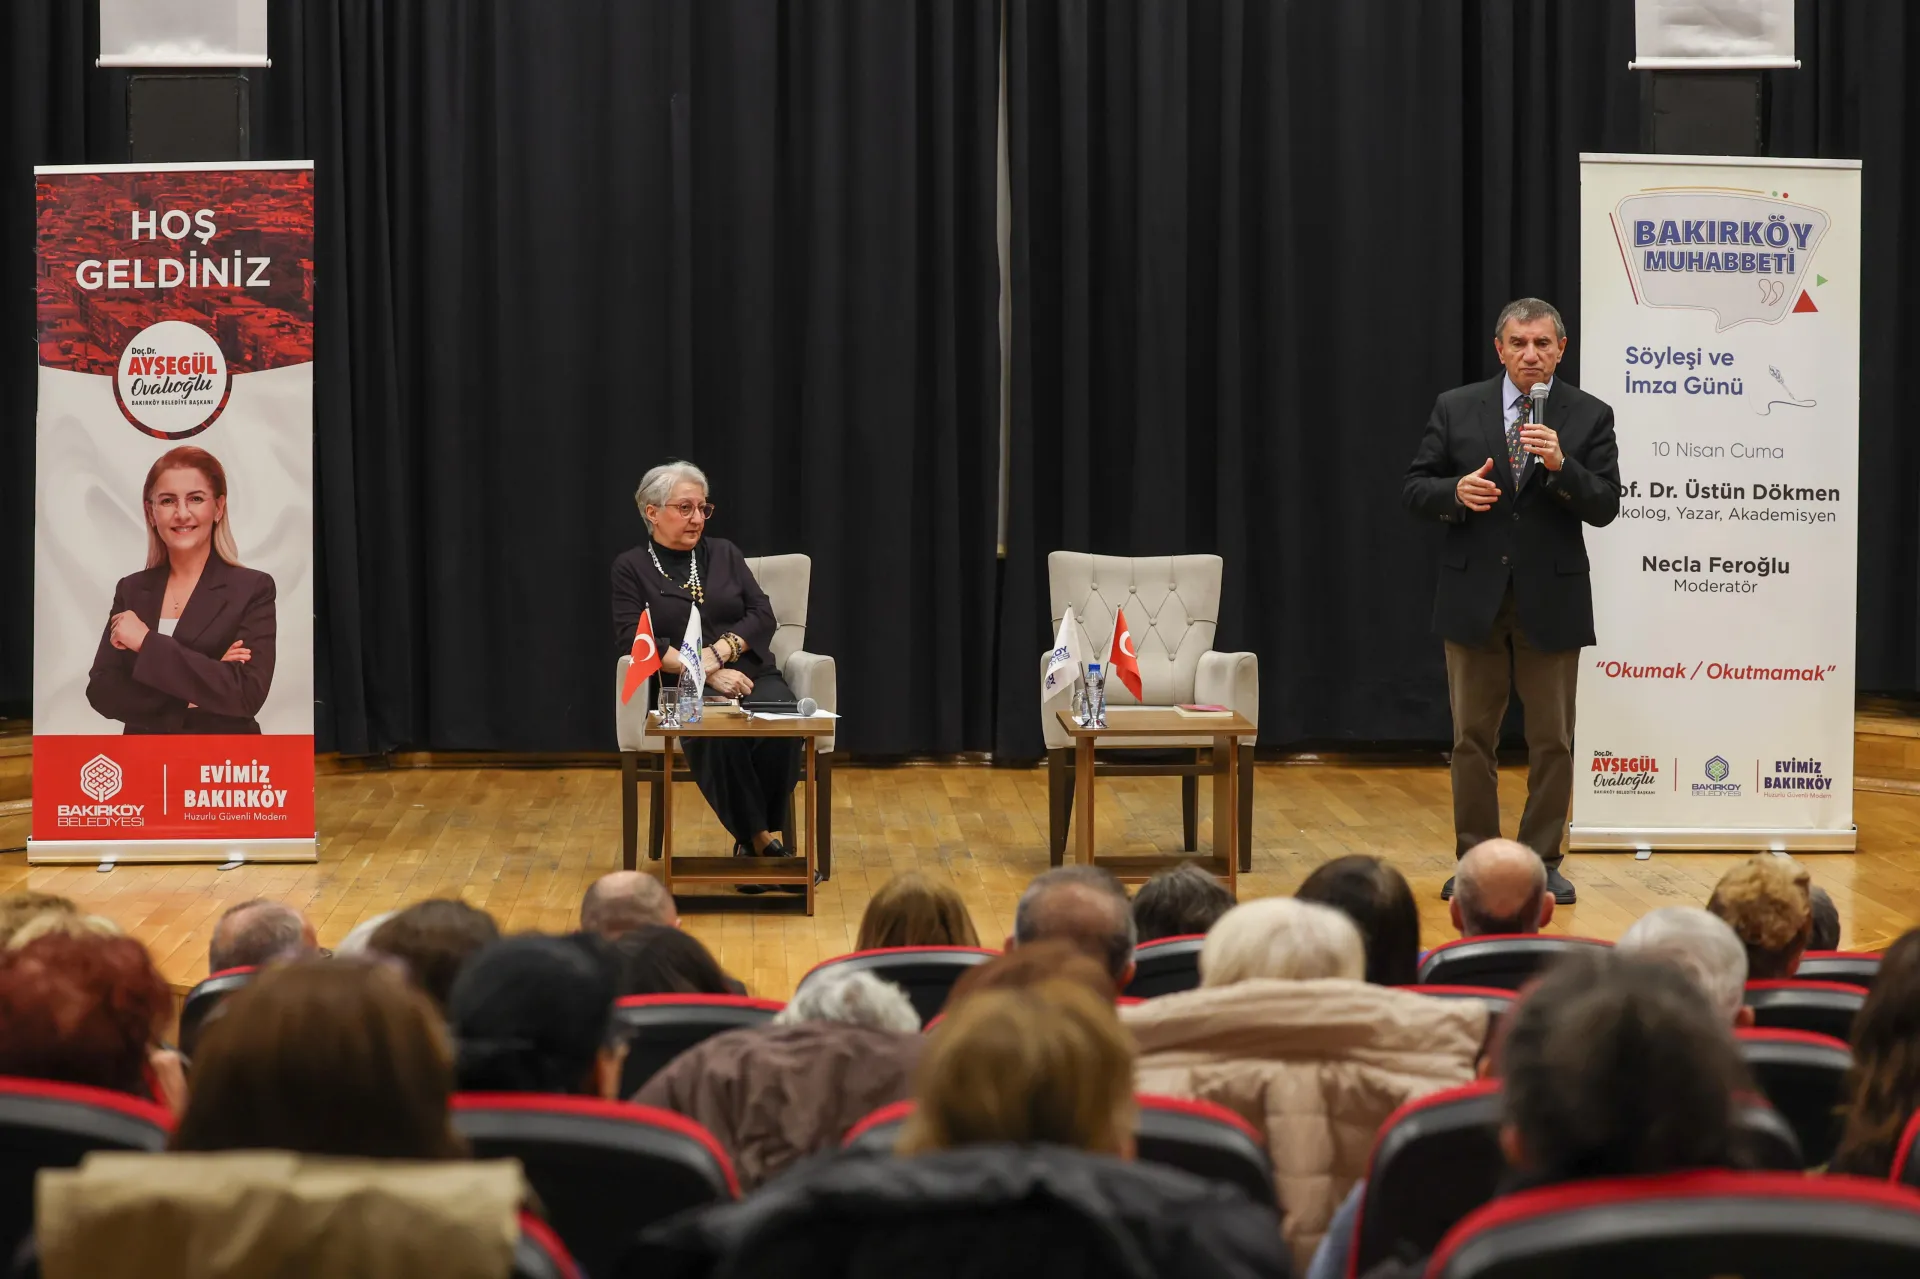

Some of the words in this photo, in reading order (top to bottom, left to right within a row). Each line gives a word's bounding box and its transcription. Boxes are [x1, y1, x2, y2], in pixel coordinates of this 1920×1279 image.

[131, 208, 217, 245] HOŞ
[1634, 213, 1813, 251] BAKIRKÖY
[75, 249, 271, 290] GELDİNİZ
[1644, 247, 1796, 274] MUHABBETİ
[127, 352, 218, 379] AYŞEGÜL
[1625, 346, 1702, 370] Söyleşi
[1708, 351, 1734, 367] ve
[131, 373, 213, 399] Ovalıoğlu
[1625, 370, 1677, 394] İmza
[1683, 376, 1744, 396] Günü
[188, 399, 214, 407] BAŞKANI
[1651, 441, 1671, 457] 10
[1676, 442, 1725, 458] Nisan
[1730, 442, 1784, 459] Cuma
[1620, 481, 1642, 498] of.
[1649, 481, 1678, 499] Dr.
[1685, 479, 1746, 500] Üstün
[1752, 483, 1841, 502] Dökmen
[1618, 505, 1670, 522] kolog,
[1676, 506, 1723, 522] Yazar,
[1728, 507, 1836, 524] Akademisyen
[1642, 556, 1702, 573] Necla
[1708, 557, 1790, 577] Feroğlu
[1674, 579, 1758, 594] Moderatör
[200, 759, 270, 783] EVİMİZ
[1591, 755, 1659, 775] AYŞEGÜL
[1775, 757, 1822, 774] EVİMİZ
[1593, 771, 1656, 791] Ovalıoğlu
[1764, 774, 1833, 791] BAKIRKÖY
[184, 784, 288, 809] BAKIRKÖY
[184, 812, 216, 821] Huzurlu
[218, 812, 251, 821] Güvenli
[253, 812, 288, 821] Modern
